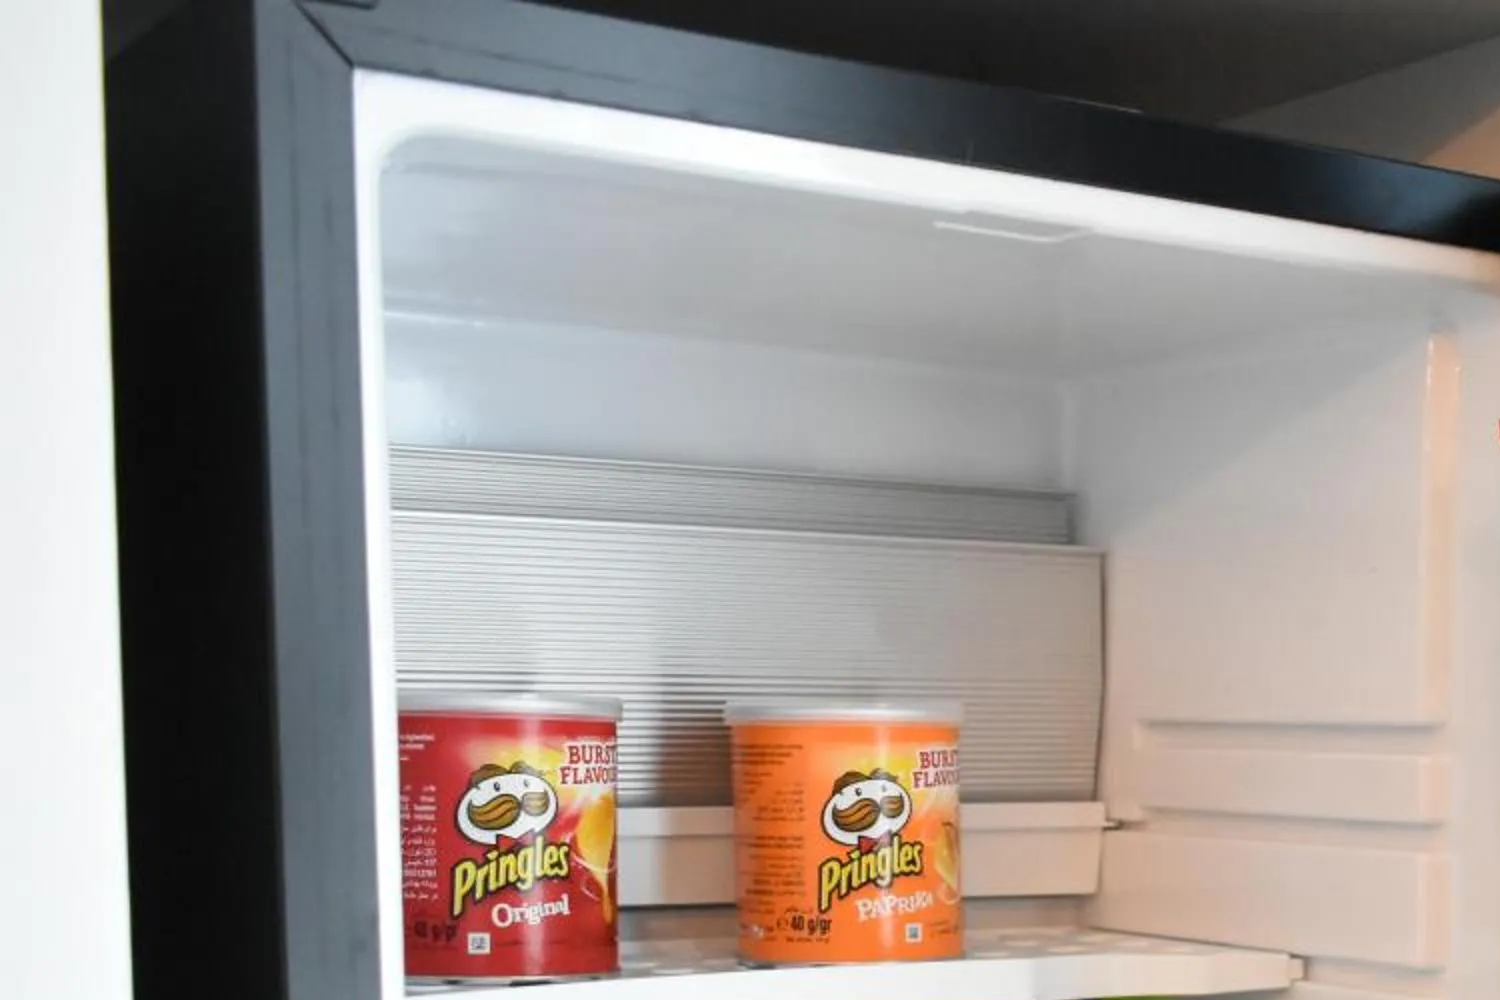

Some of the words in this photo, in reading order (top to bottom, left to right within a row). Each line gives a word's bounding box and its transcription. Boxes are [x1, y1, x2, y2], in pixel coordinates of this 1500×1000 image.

[451, 834, 570, 918] Pringles
[491, 893, 572, 928] Original
[818, 832, 924, 914] Pringles
